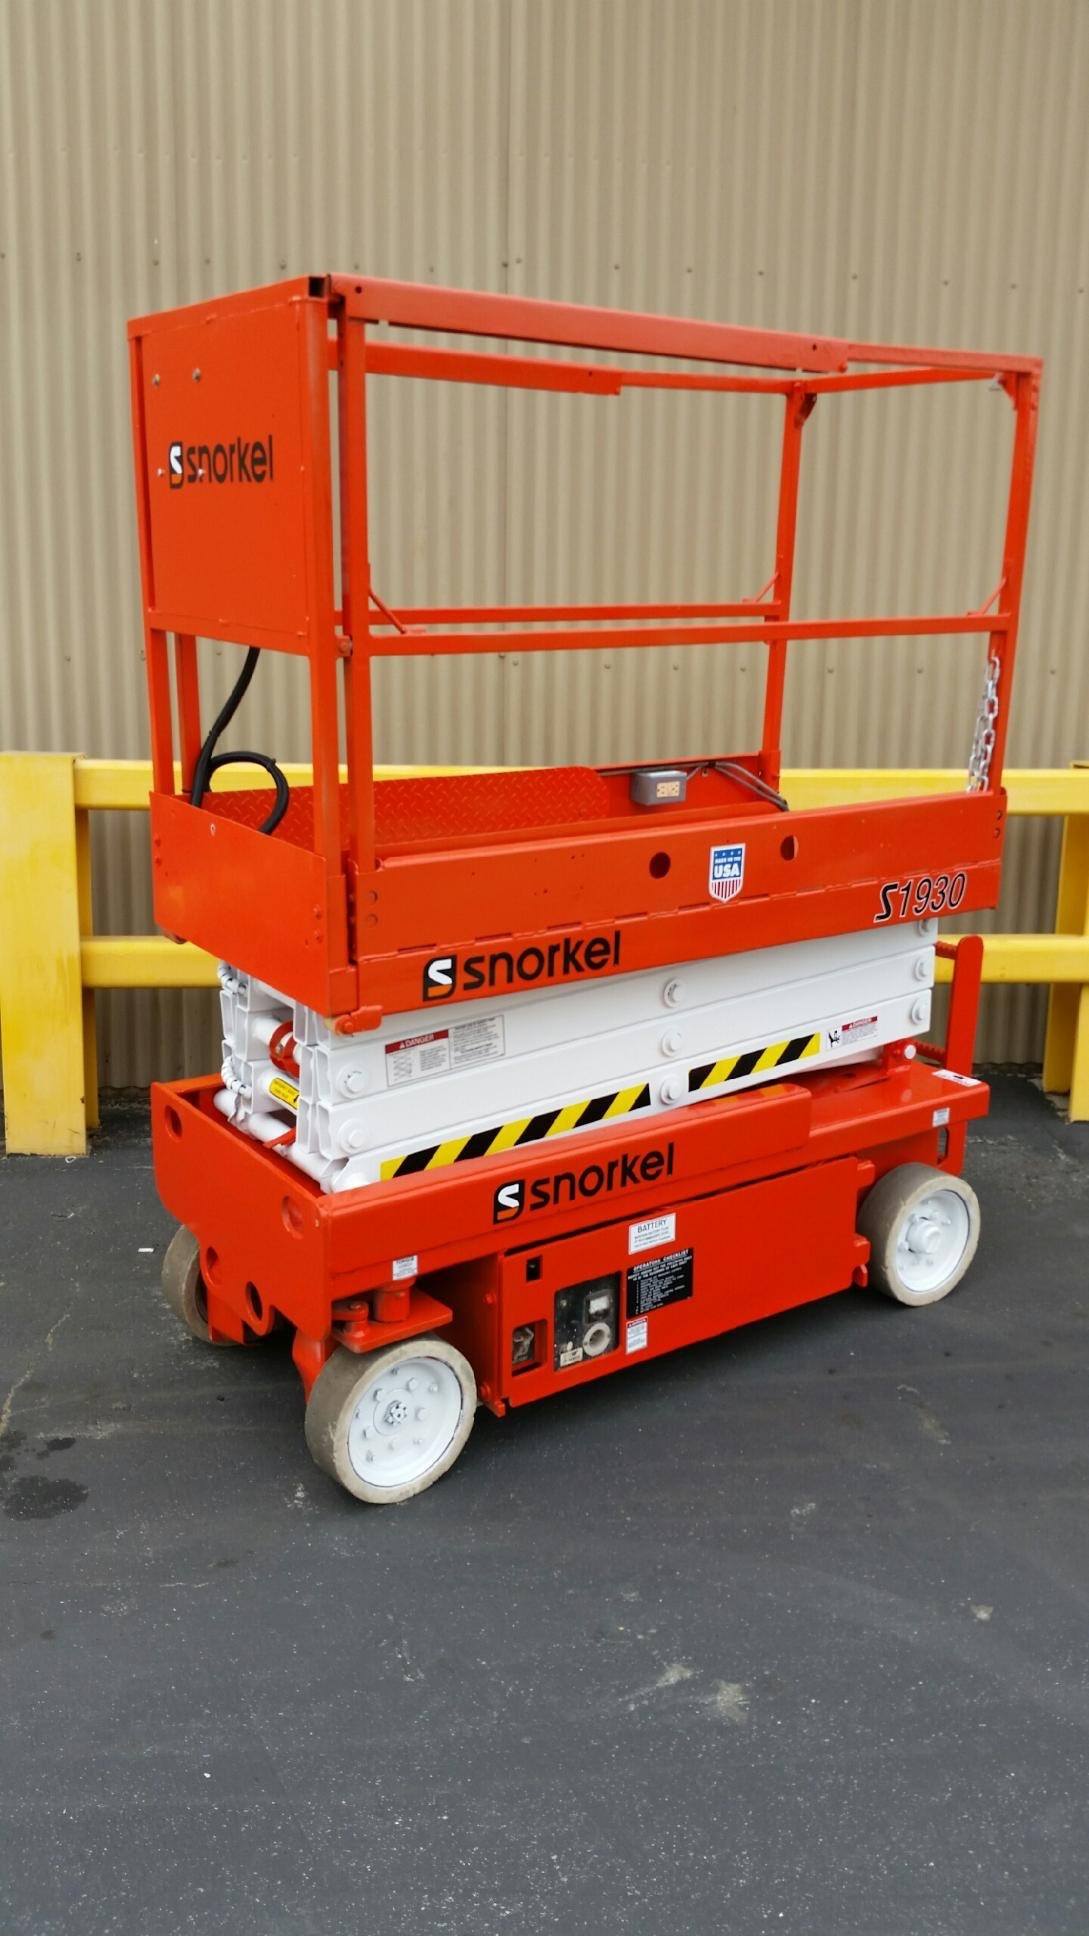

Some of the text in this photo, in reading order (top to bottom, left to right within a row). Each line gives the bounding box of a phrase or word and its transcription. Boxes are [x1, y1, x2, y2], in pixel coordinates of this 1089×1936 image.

[187, 434, 273, 484] snorkel
[713, 862, 741, 879] USA
[873, 871, 968, 923] S1930
[463, 930, 621, 991] snorkel
[405, 1033, 435, 1048] DANGER
[529, 1142, 675, 1211] snorkel
[637, 1219, 667, 1233] BATTERY
